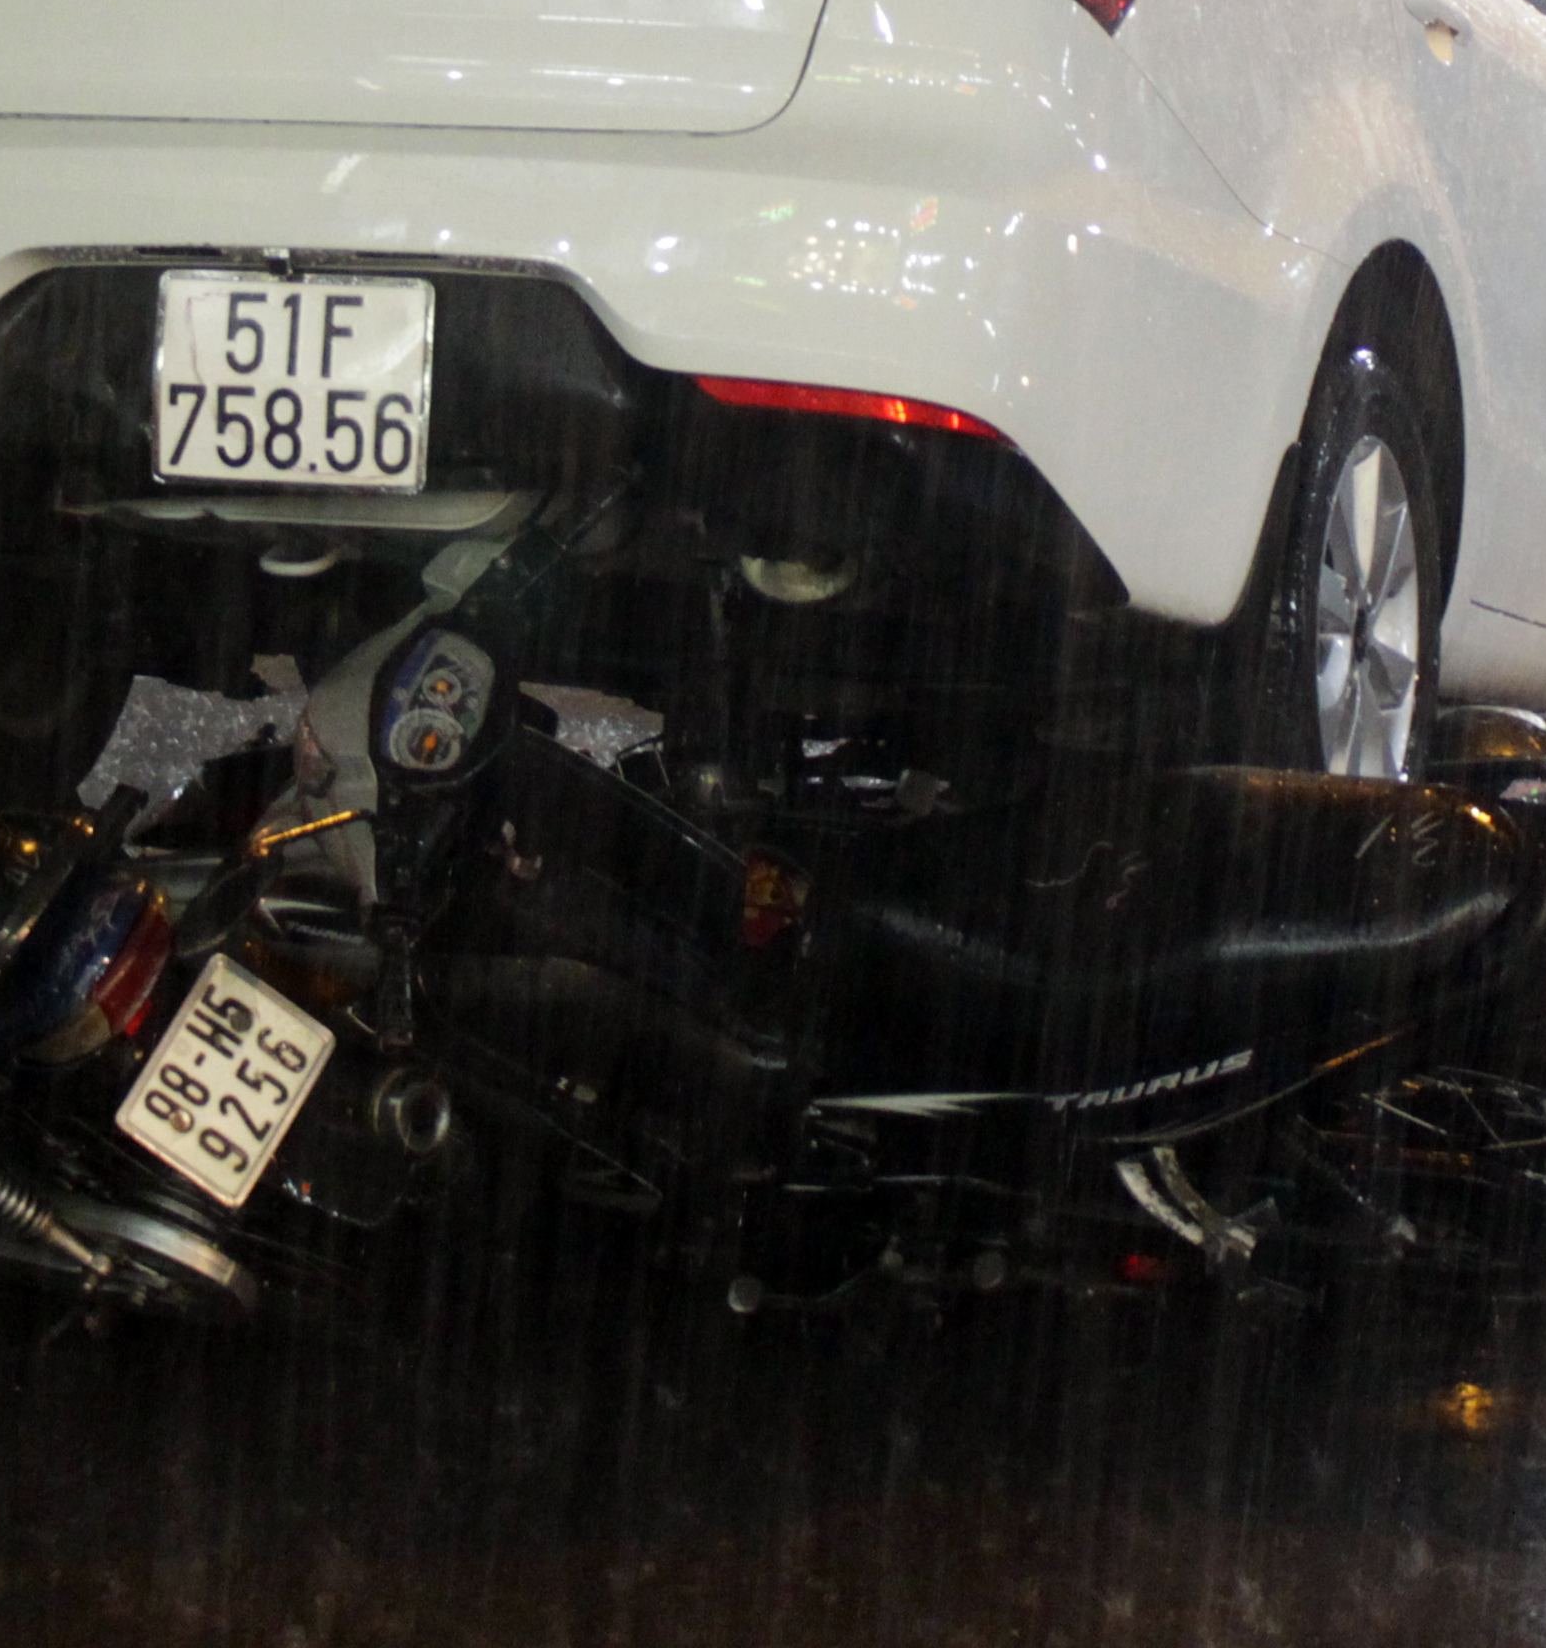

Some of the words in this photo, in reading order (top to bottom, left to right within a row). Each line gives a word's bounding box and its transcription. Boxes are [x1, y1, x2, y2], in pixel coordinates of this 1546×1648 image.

[224, 290, 365, 379] 51F
[166, 383, 413, 475] 758.56
[196, 1028, 310, 1176] 9256
[1043, 1048, 1254, 1112] TAURUS
